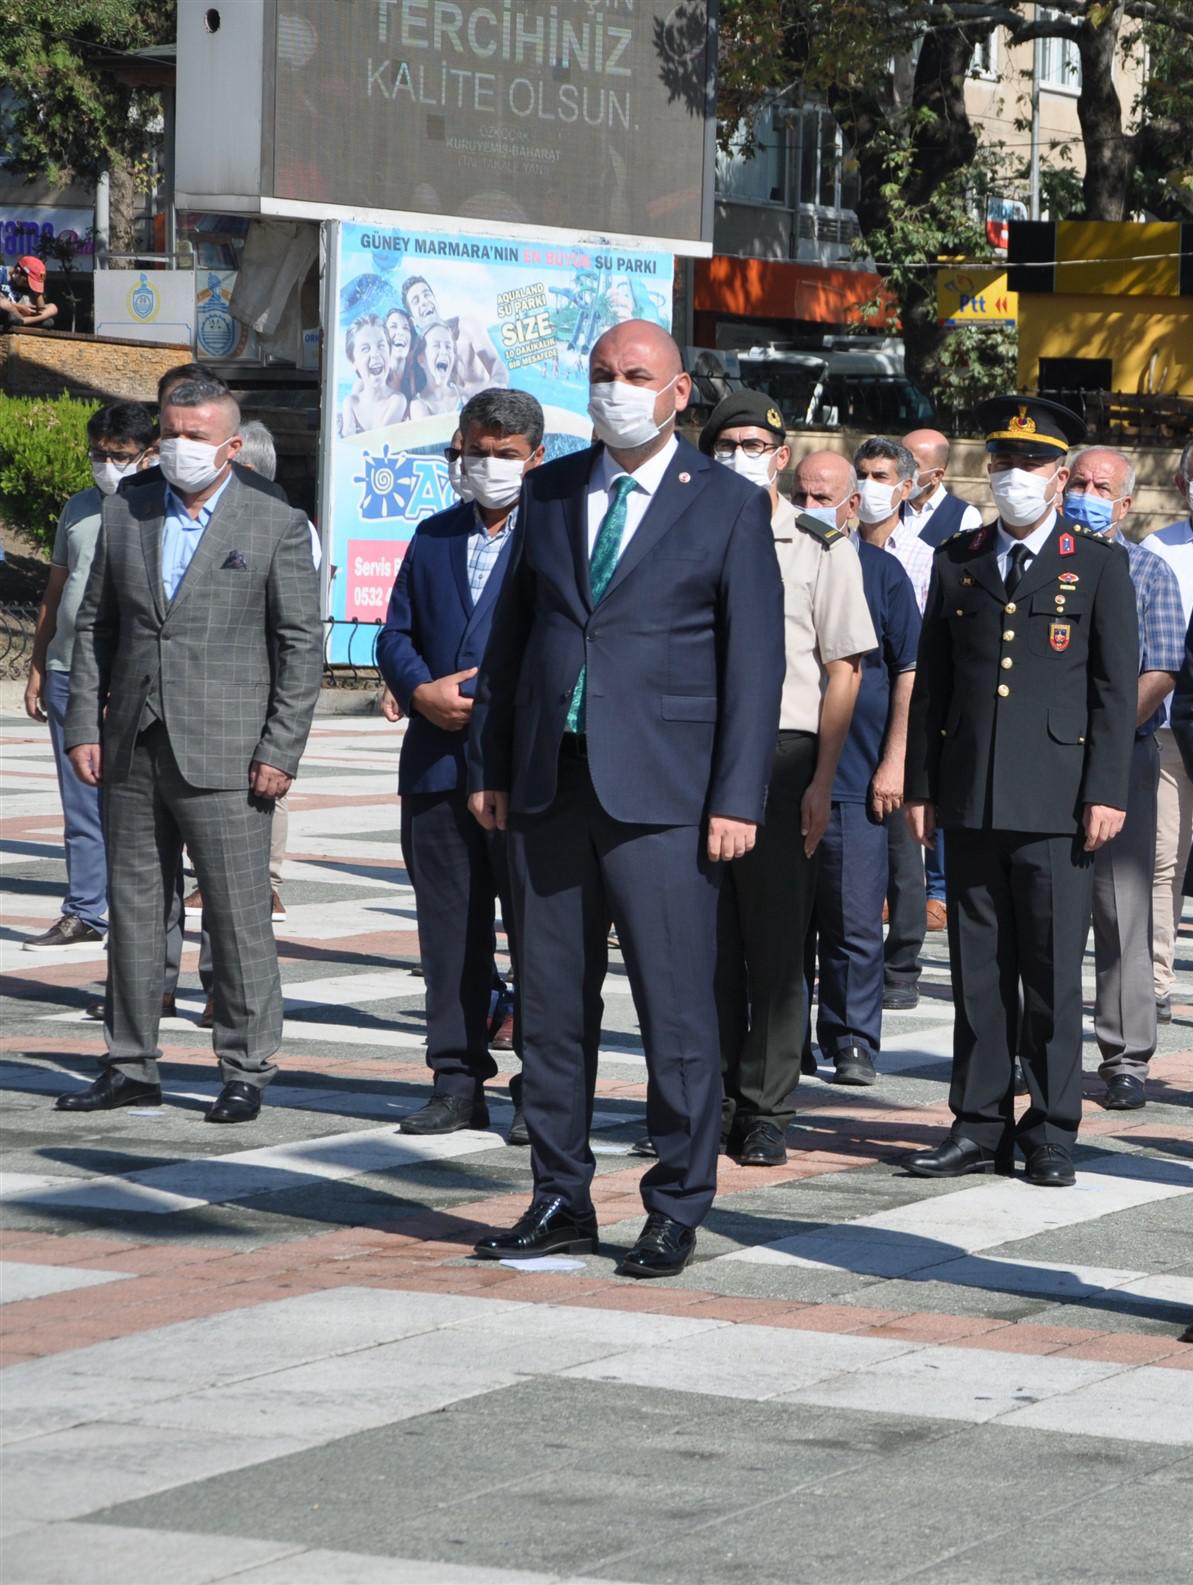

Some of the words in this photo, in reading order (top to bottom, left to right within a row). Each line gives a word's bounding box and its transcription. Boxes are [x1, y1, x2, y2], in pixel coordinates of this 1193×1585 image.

[367, 57, 496, 112] KALİTE
[509, 78, 640, 131] OLSUN.
[360, 231, 410, 251] GÜNEY
[594, 256, 613, 270] SU
[617, 259, 657, 274] PARKI
[497, 282, 545, 305] AQUALAND
[960, 294, 987, 313] Ptt
[498, 303, 512, 319] SU
[514, 294, 547, 314] PARKI
[502, 311, 553, 347] SİZE
[354, 556, 391, 577] Servis
[354, 587, 383, 606] 0532
